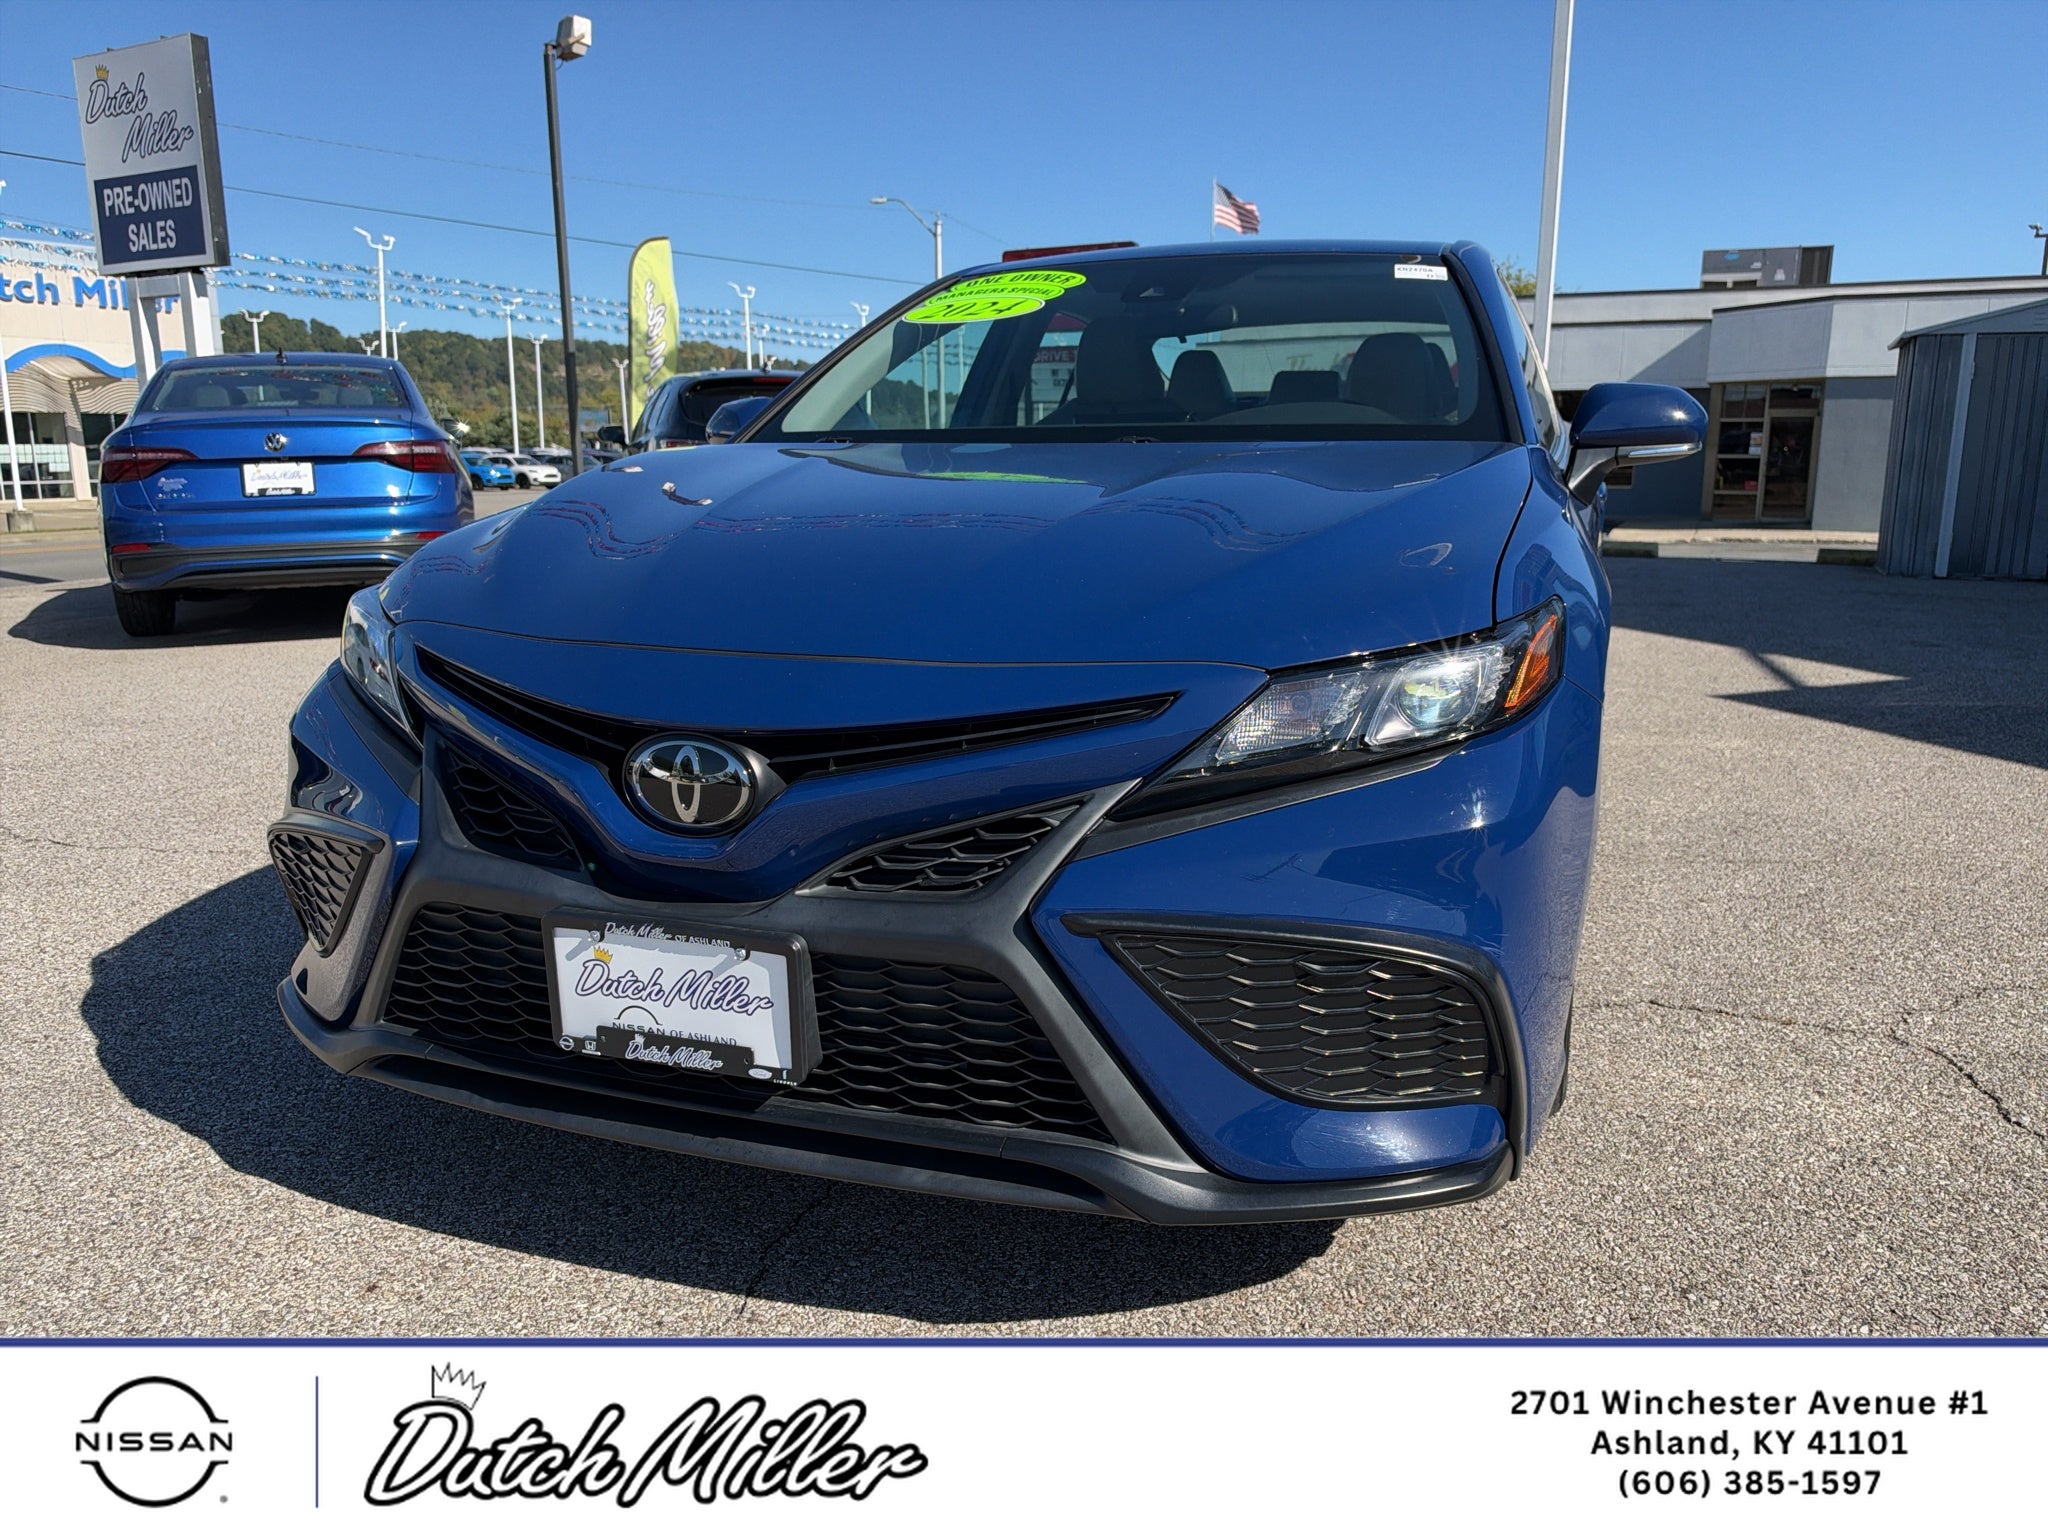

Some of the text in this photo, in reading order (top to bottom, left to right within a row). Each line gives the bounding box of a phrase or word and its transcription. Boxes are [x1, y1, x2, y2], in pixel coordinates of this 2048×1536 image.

[85, 71, 149, 124] Dutch
[121, 109, 195, 163] Miller
[103, 176, 193, 217] PRE-OWNED
[128, 218, 177, 253] SALES
[935, 286, 1054, 303] MANAGERS SPECIAL
[966, 272, 1077, 288] ONE OWNER
[919, 299, 1029, 320] 2024
[604, 922, 730, 948] Dutch Miller OF ASHLAND
[575, 958, 774, 1016] Dutch Miller
[612, 1022, 737, 1046] NISSAN OF ASHLAND
[625, 1040, 723, 1071] Dutch Miller
